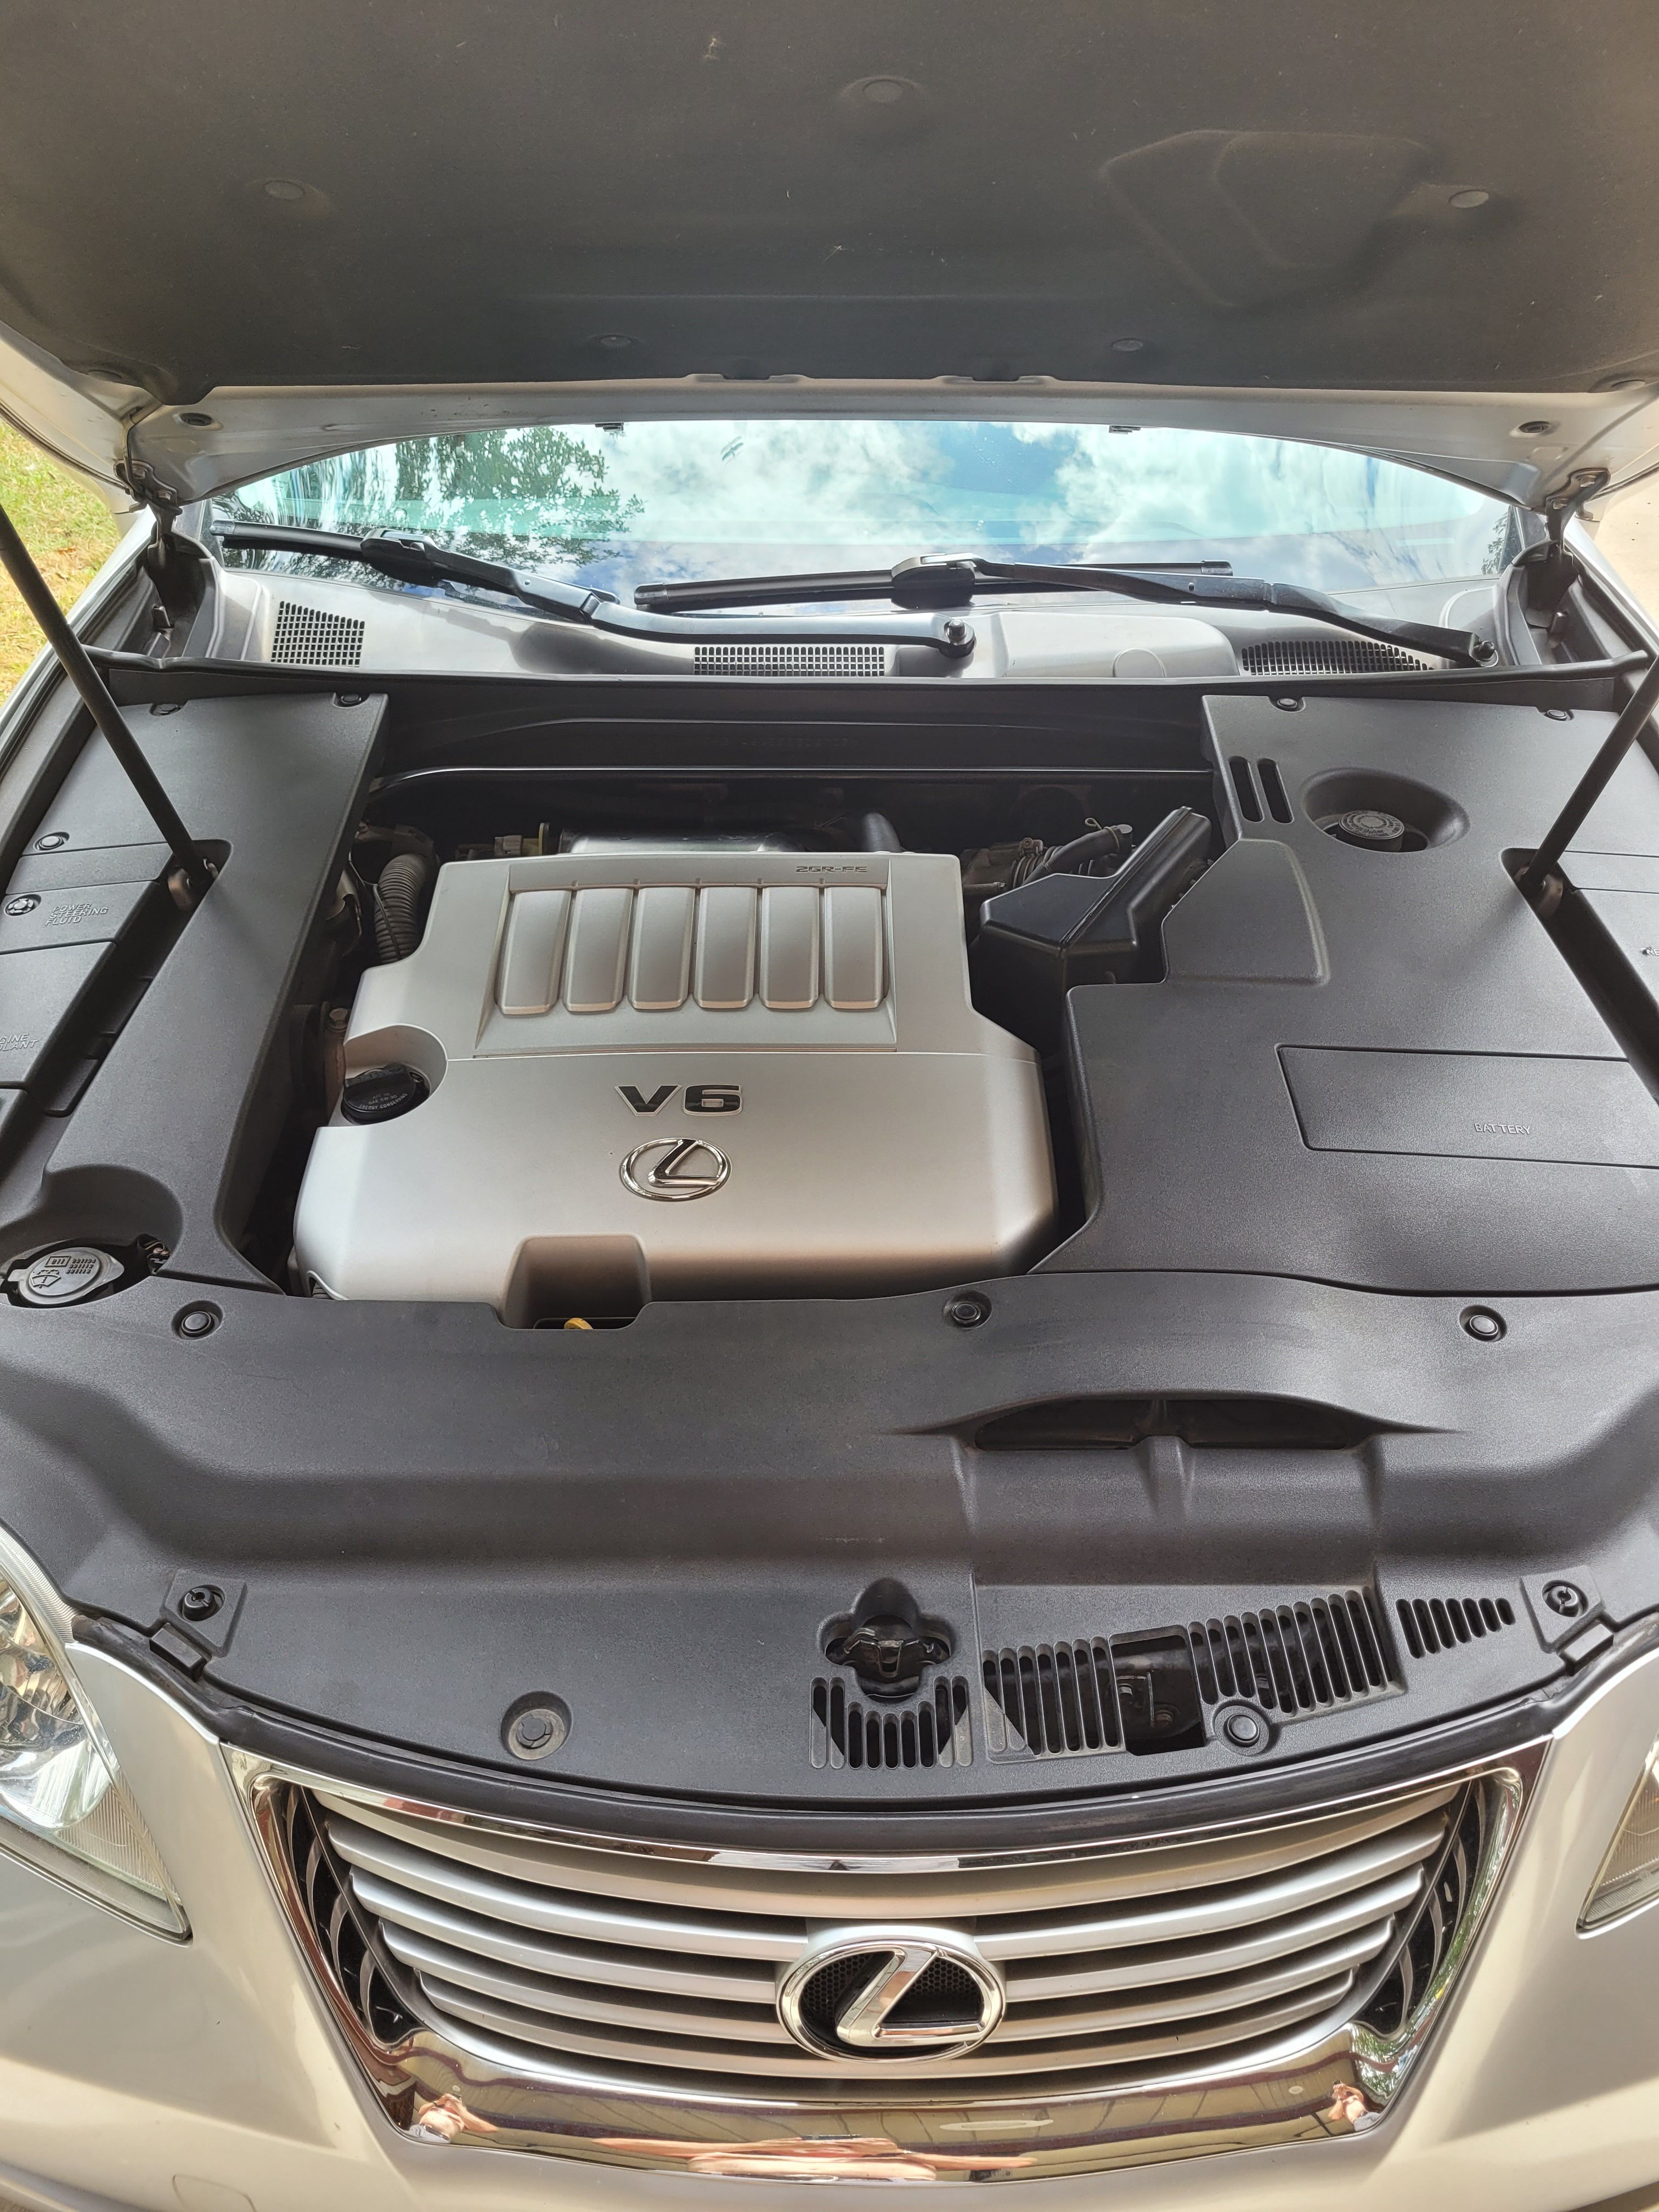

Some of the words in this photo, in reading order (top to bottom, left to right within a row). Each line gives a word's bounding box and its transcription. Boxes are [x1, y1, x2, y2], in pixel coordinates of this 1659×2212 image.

[49, 906, 109, 919] STEERING
[52, 902, 92, 912] POWER
[45, 916, 82, 926] FLUID
[615, 1084, 742, 1116] V6
[1474, 1123, 1530, 1135] BATTERY
